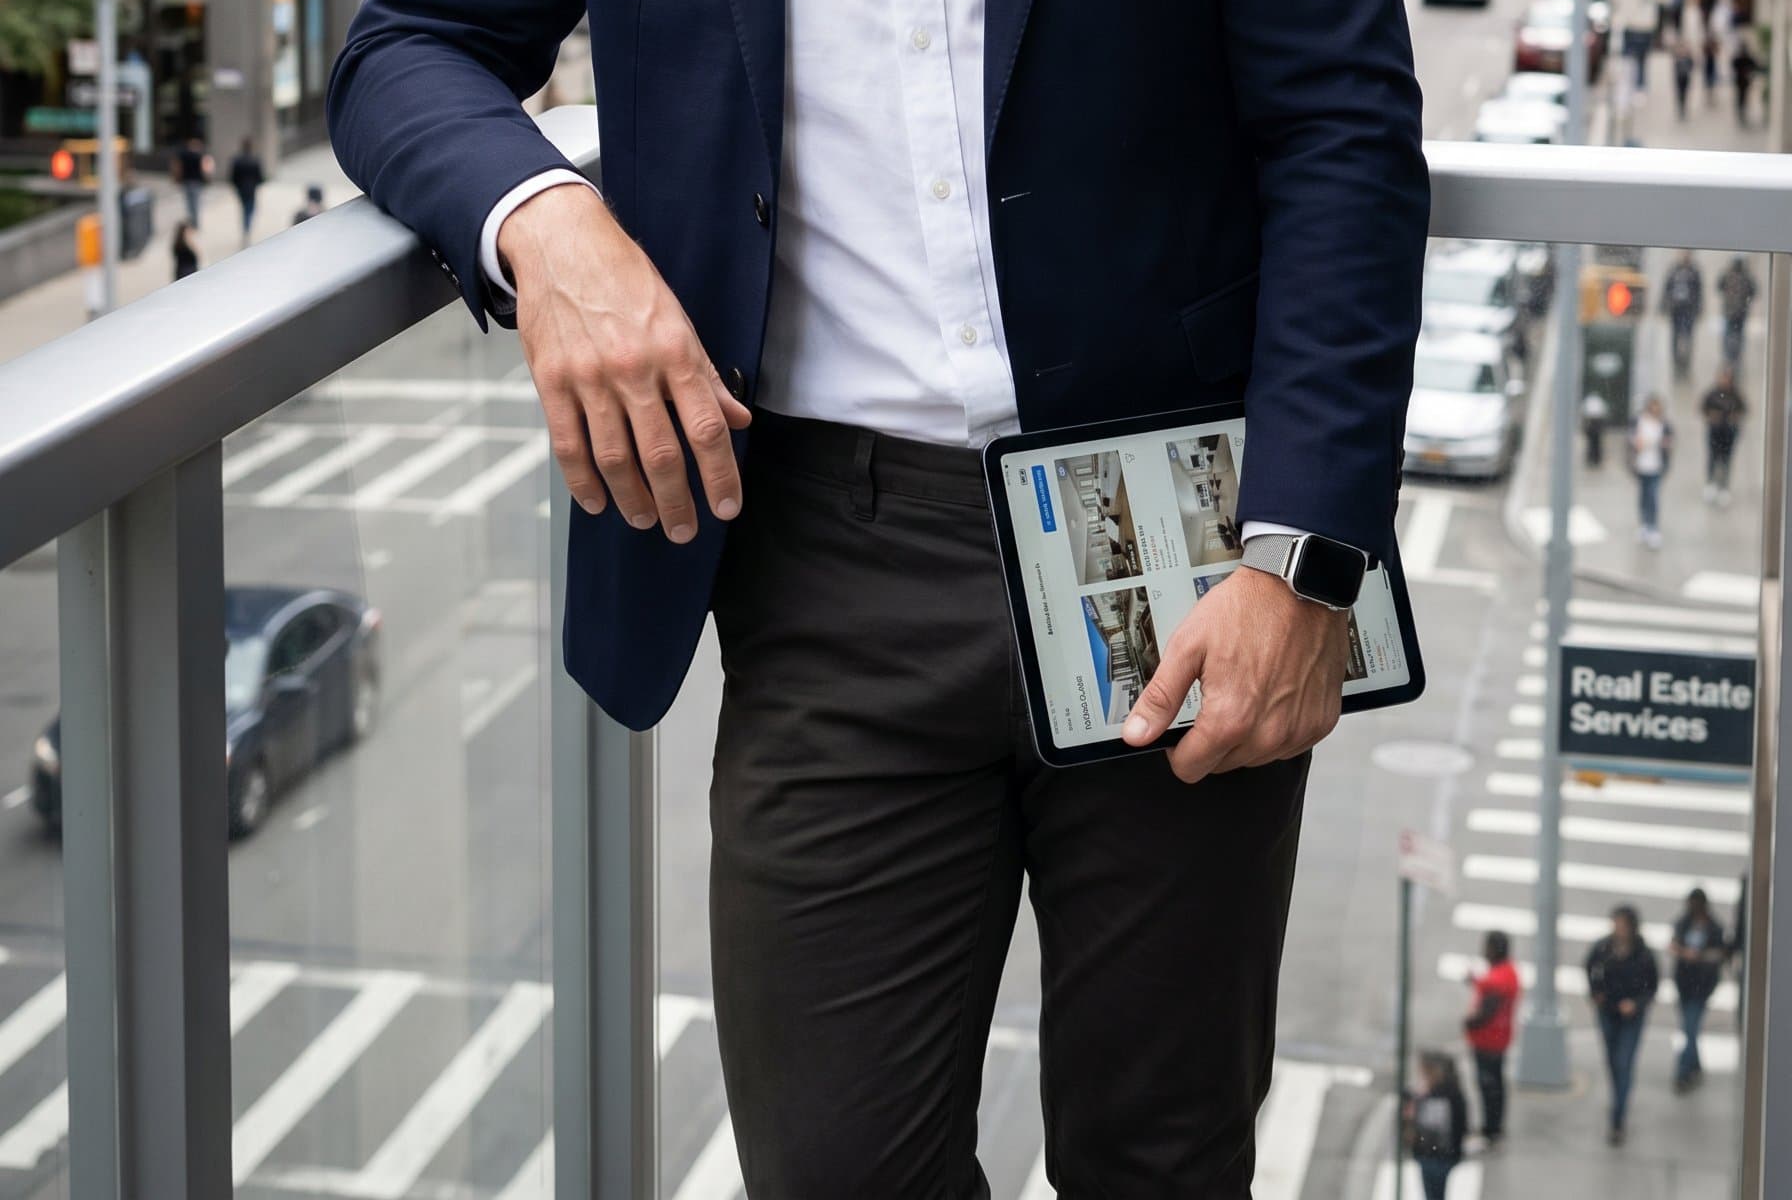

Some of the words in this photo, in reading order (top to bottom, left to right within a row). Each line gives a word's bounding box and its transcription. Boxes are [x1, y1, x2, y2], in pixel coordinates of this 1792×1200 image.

[1571, 666, 1642, 700] Real
[1651, 672, 1752, 710] Estate
[1570, 702, 1708, 742] Services
